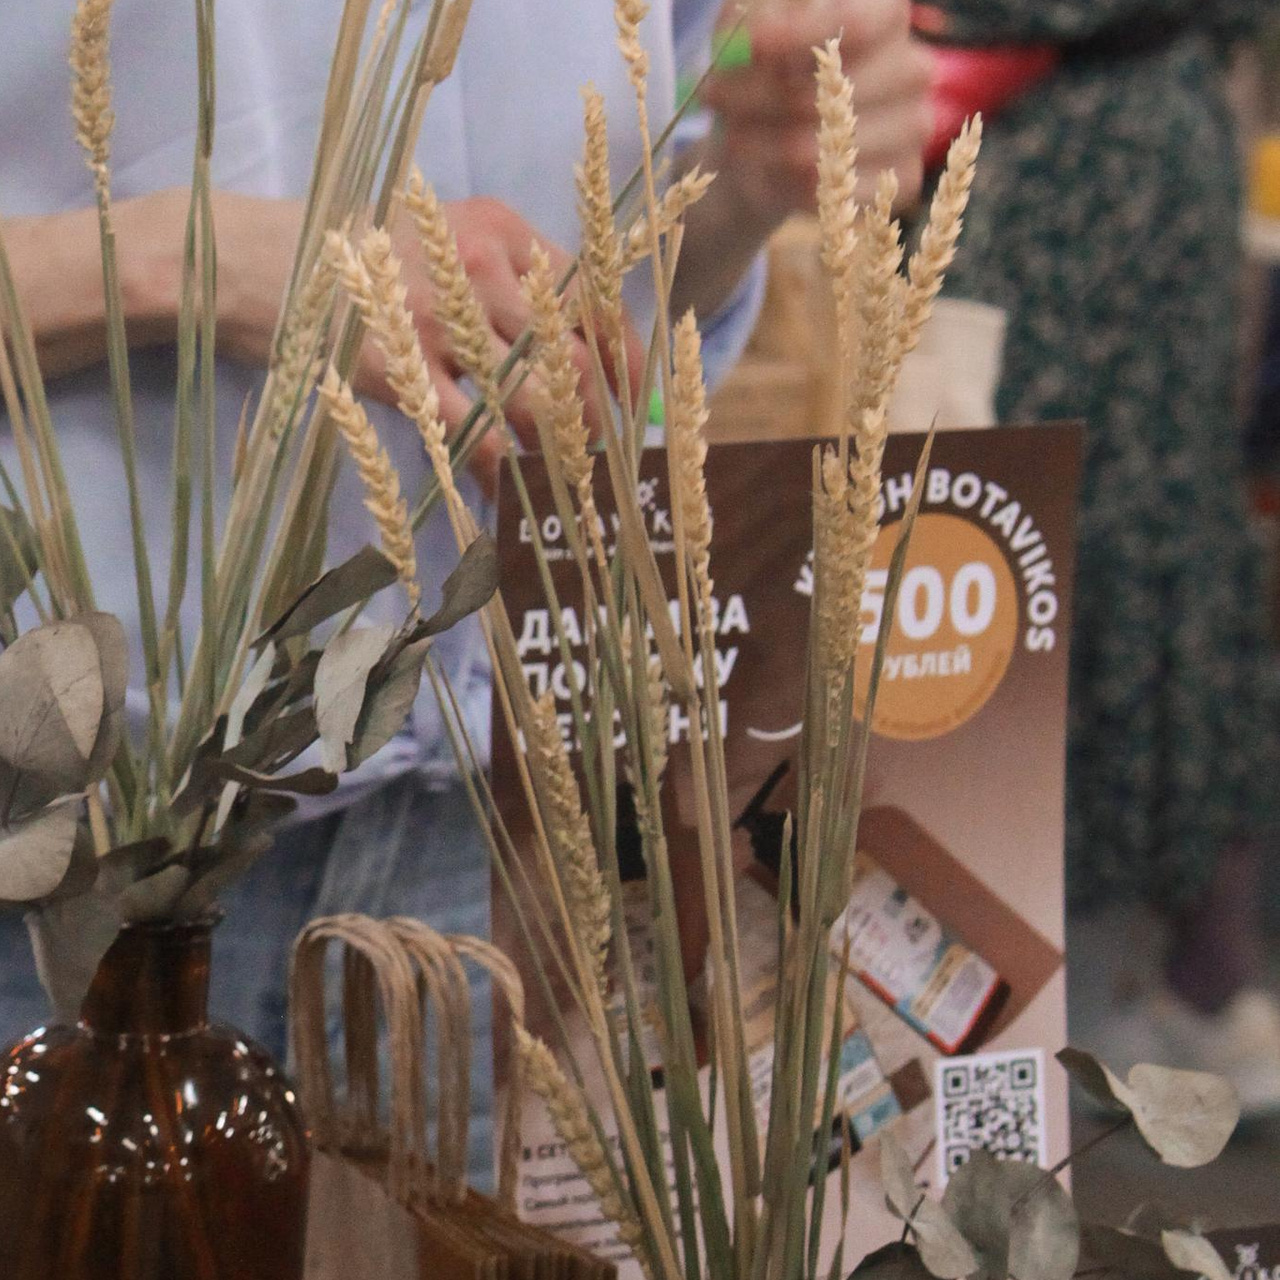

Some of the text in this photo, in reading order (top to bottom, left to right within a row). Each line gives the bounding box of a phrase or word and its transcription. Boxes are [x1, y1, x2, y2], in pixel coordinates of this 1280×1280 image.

[925, 467, 1060, 652] BOTAVIKOS
[859, 560, 997, 644] 500
[883, 643, 972, 681] УБЛЕЙ
